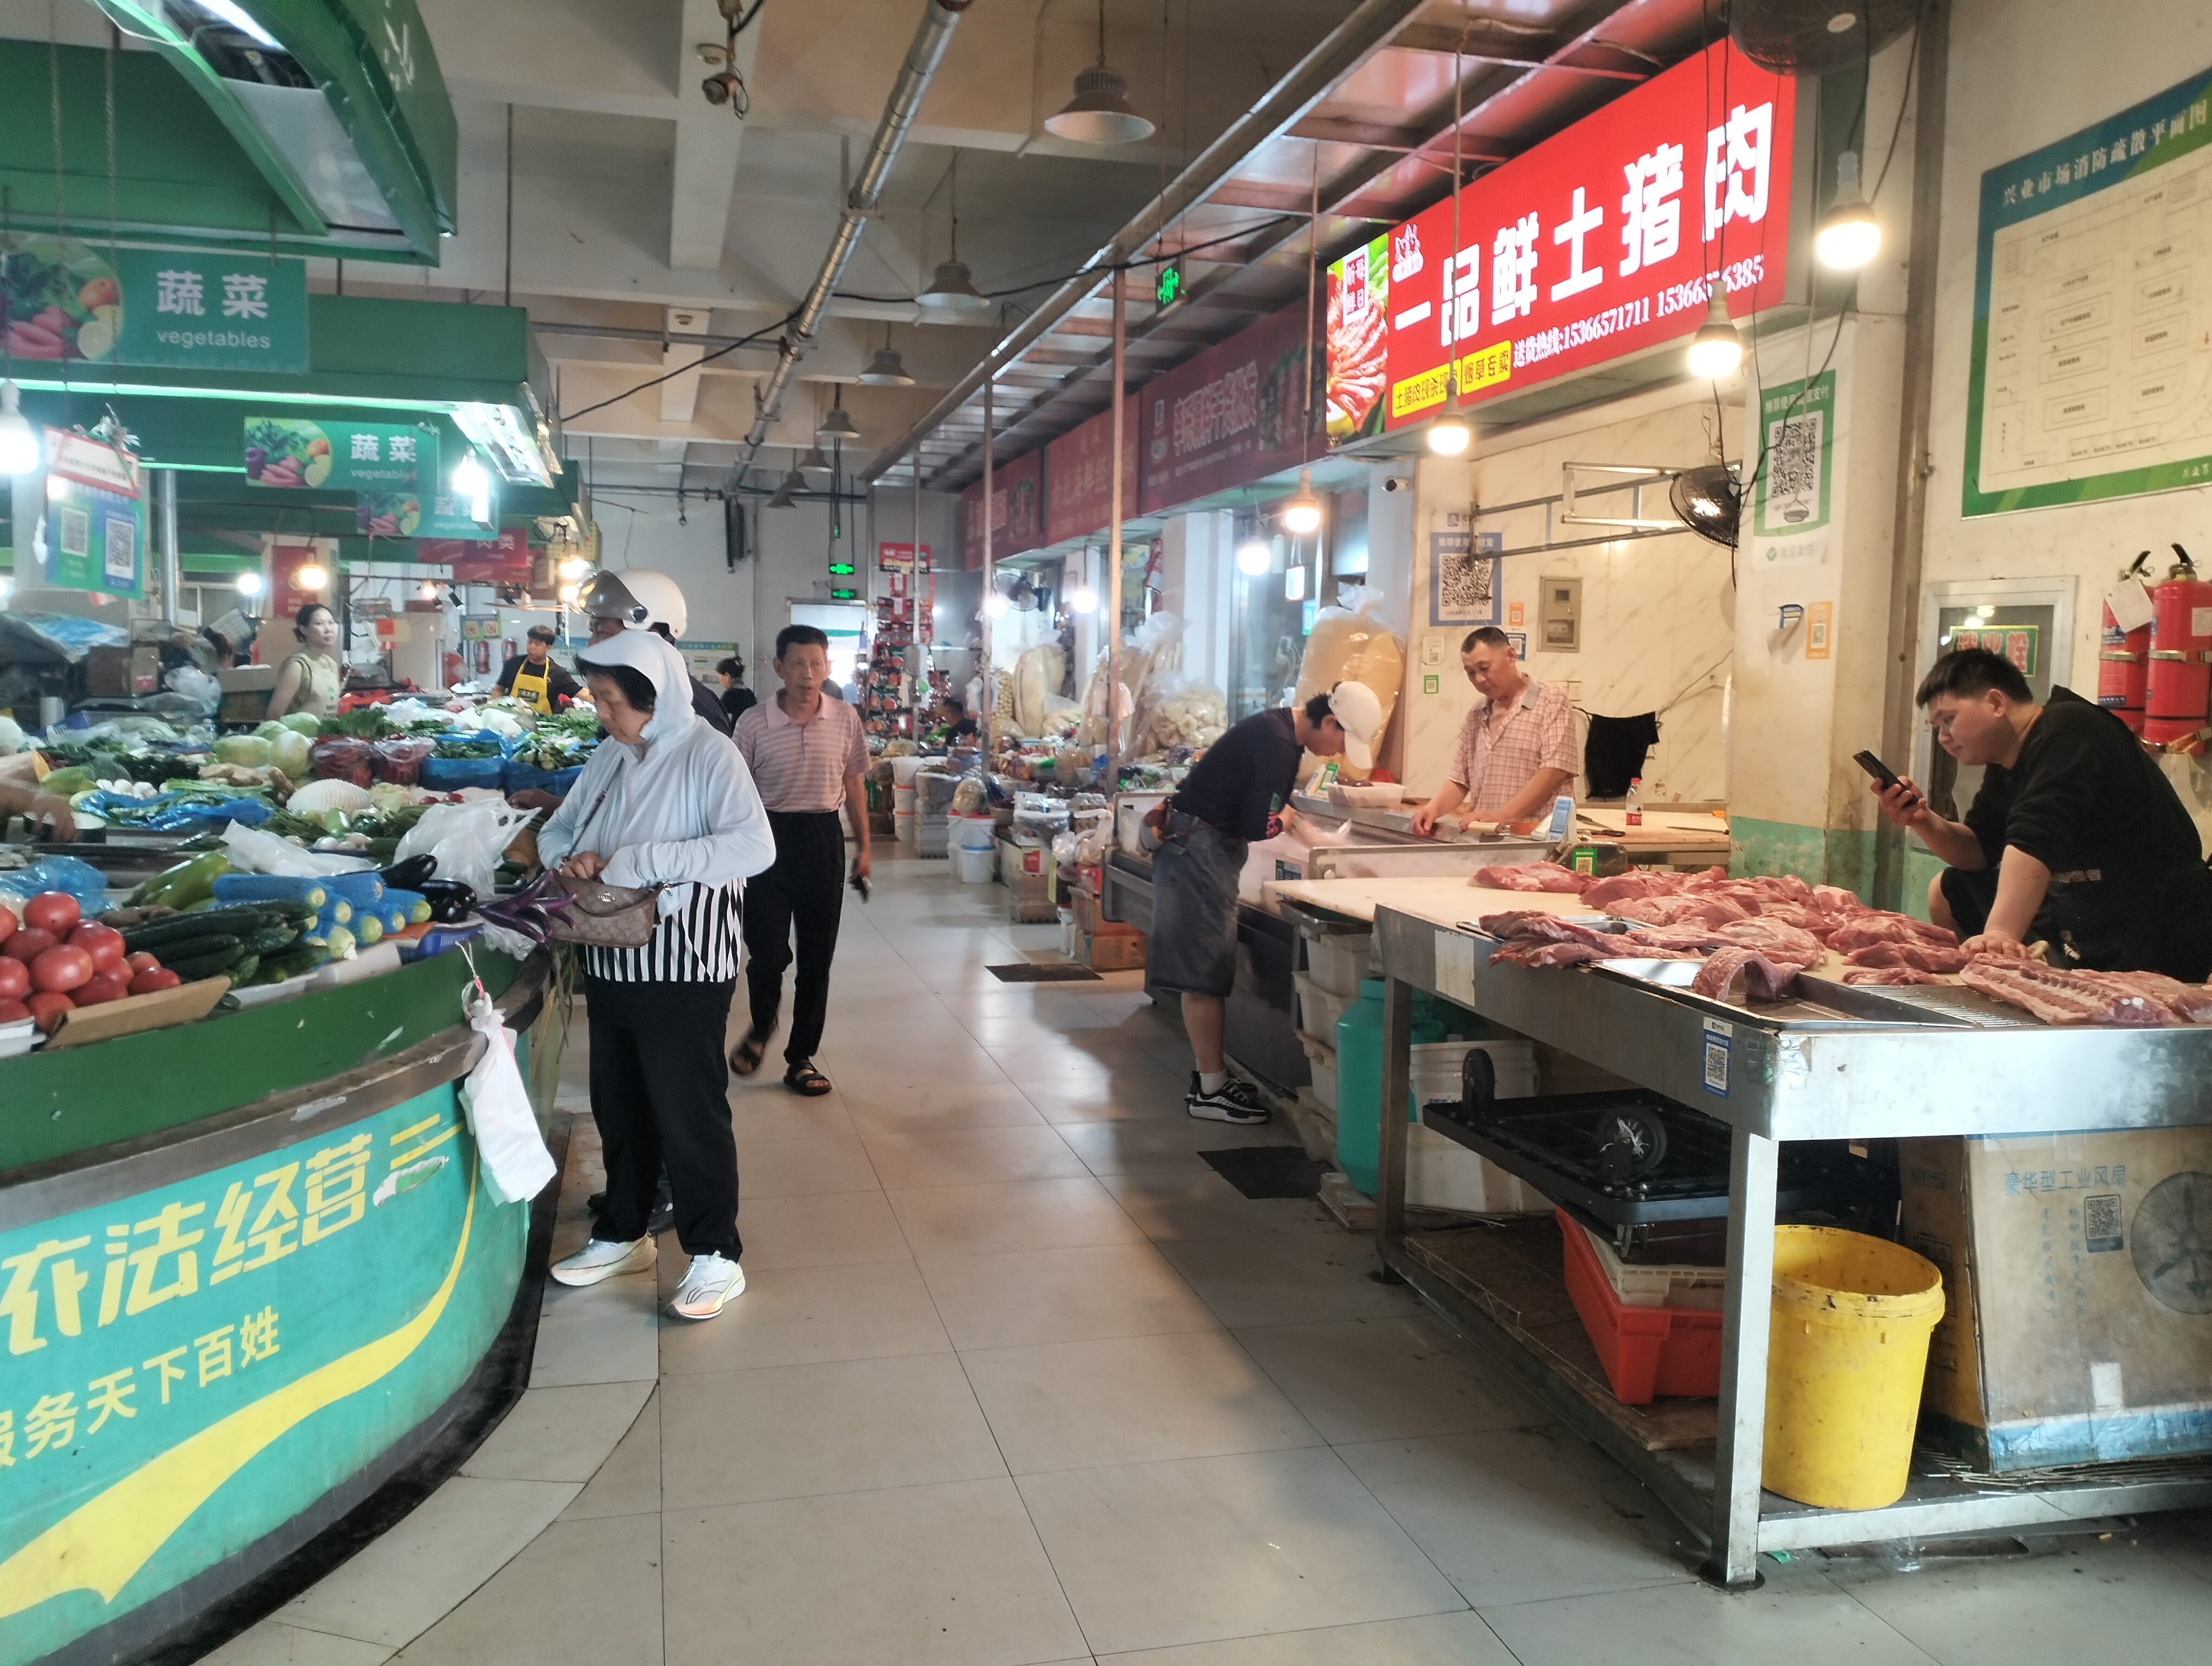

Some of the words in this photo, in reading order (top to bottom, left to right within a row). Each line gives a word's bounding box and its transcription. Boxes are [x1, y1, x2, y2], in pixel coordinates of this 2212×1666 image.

[1394, 102, 1773, 347] 一品鲜土猪肉
[157, 270, 267, 319] 蔬菜
[1656, 253, 1765, 318] 1536656385
[157, 330, 271, 349] vegetables
[1396, 369, 1457, 409] 土猪肉现杀现
[351, 433, 416, 463] 蔬菜
[2004, 1165, 2126, 1196] 豪华型工业风扇
